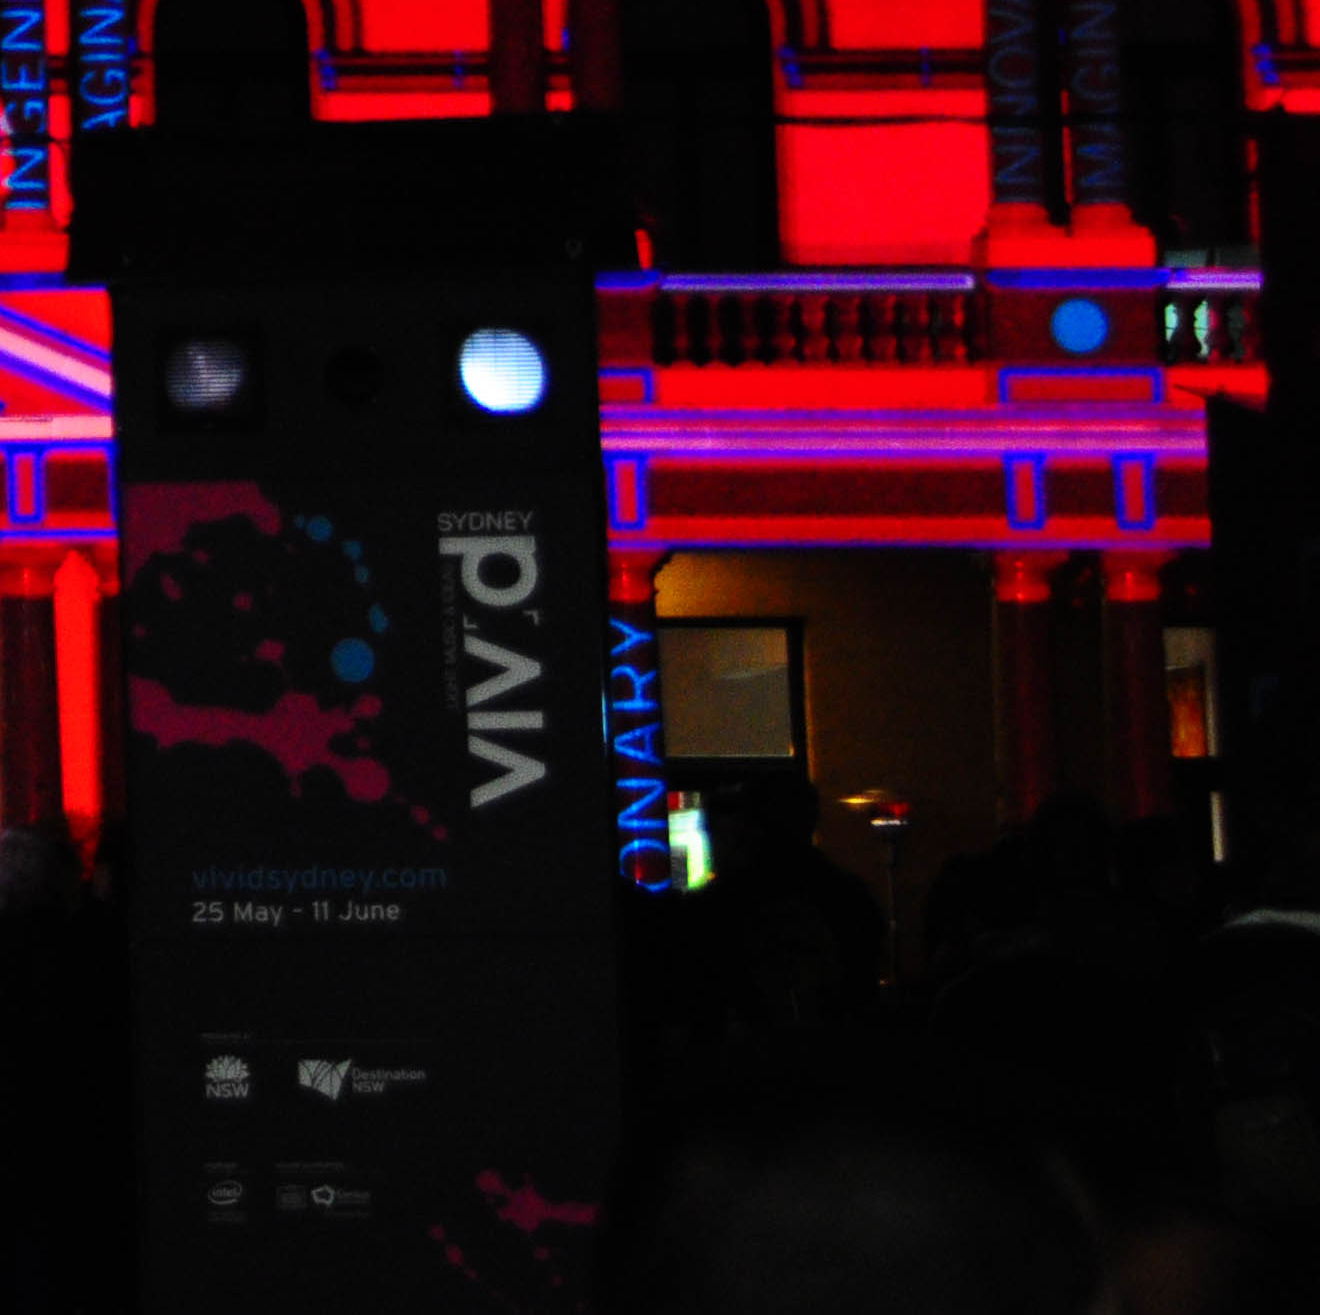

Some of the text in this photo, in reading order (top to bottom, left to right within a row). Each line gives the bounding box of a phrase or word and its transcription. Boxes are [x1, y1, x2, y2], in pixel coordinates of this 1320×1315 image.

[437, 510, 534, 532] SYDNEY
[192, 901, 224, 922] 25
[233, 900, 283, 926] May
[311, 900, 329, 921] 11
[339, 899, 400, 921] June
[351, 1067, 426, 1081] Destination
[205, 1084, 249, 1099] NSW
